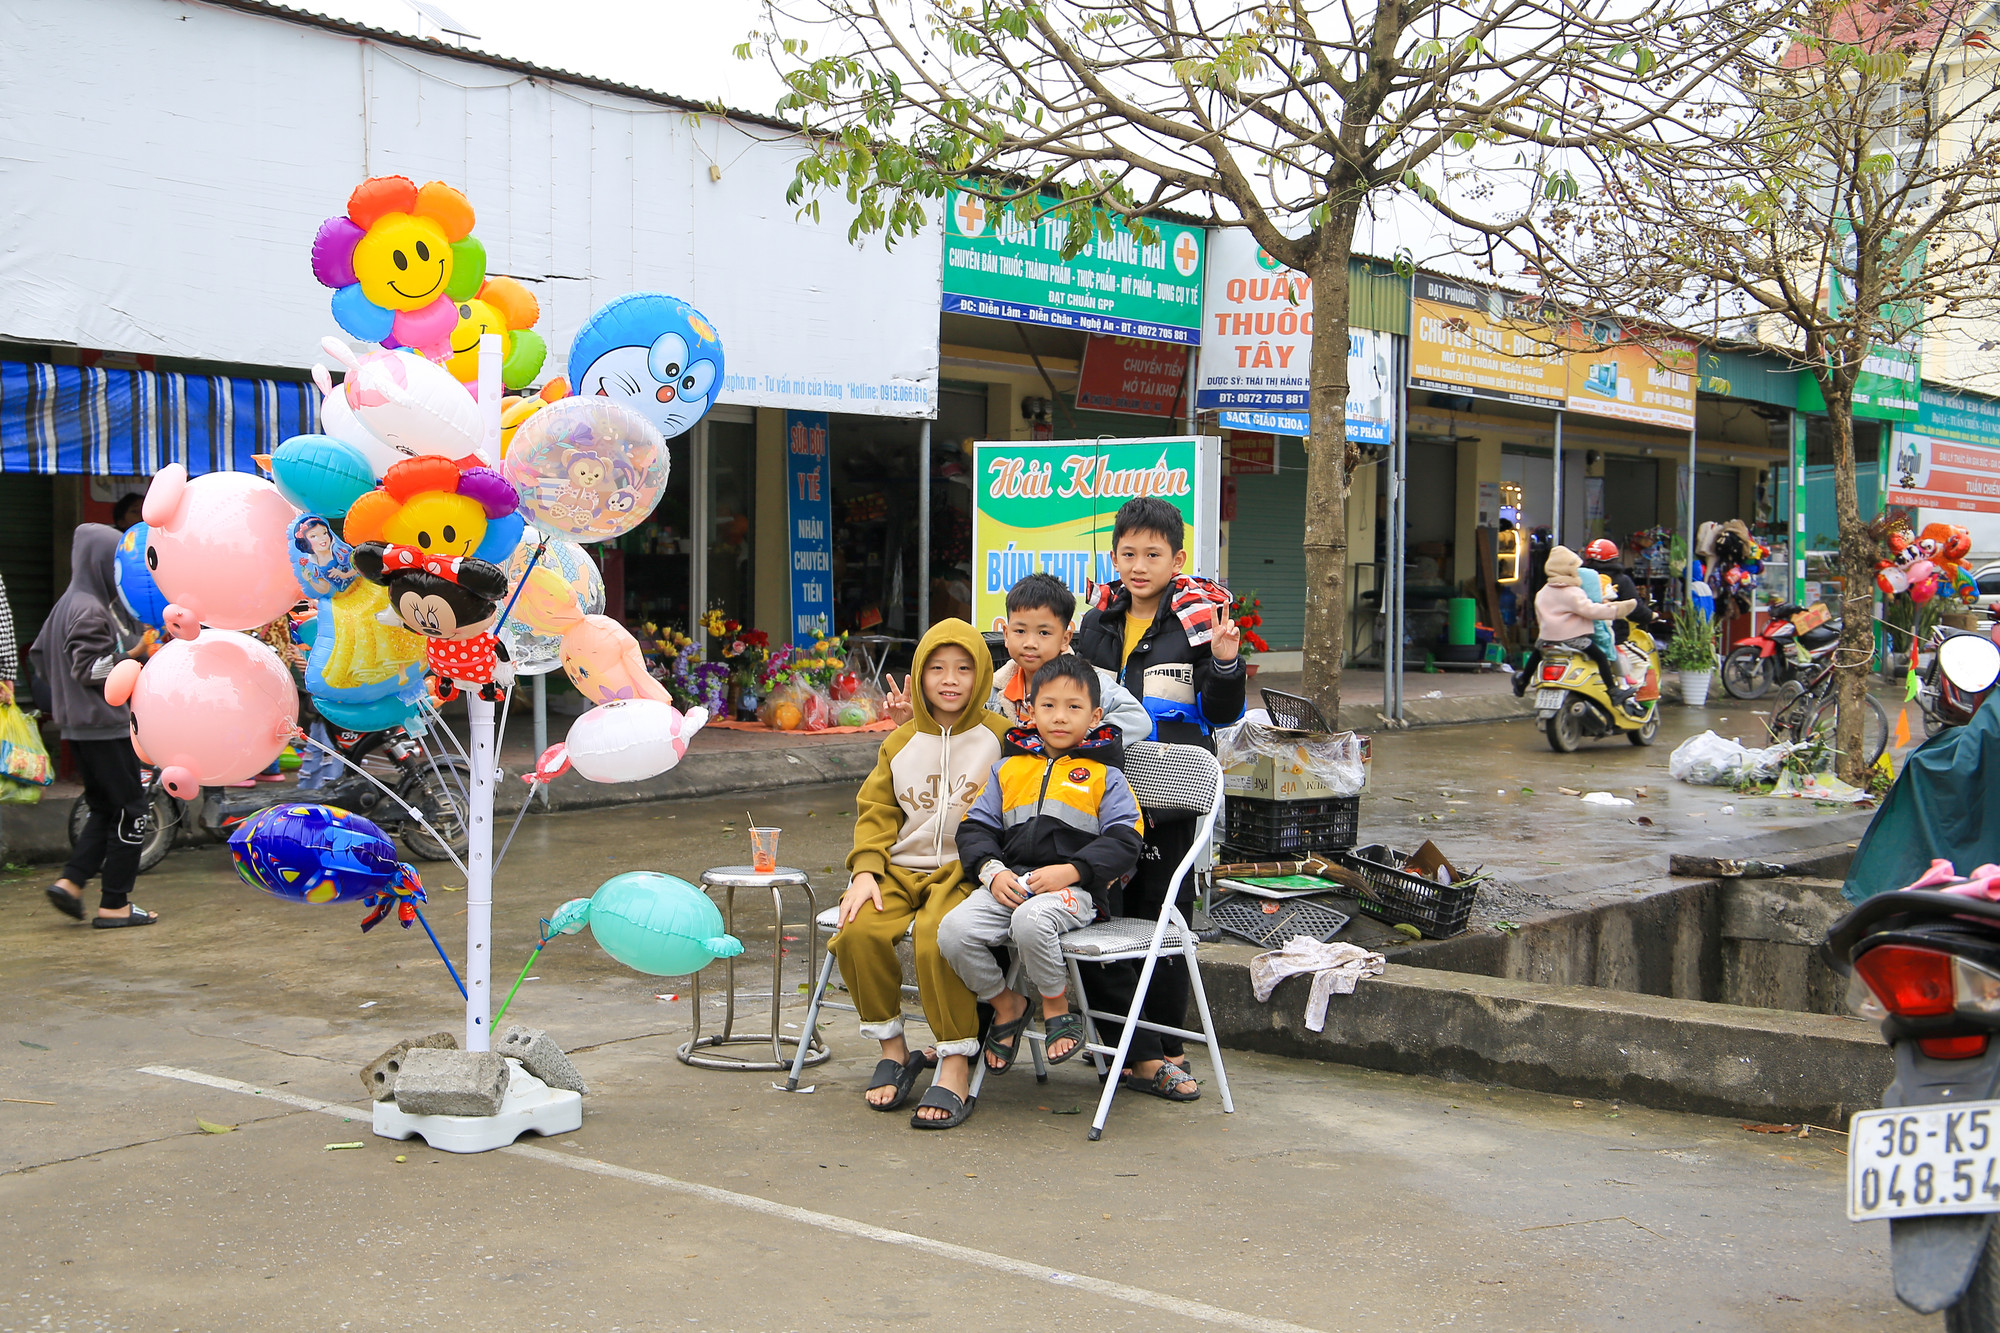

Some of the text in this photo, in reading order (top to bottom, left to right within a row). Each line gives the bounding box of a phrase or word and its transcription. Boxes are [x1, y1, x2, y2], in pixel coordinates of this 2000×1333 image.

[1043, 217, 1093, 257] THC
[949, 247, 980, 270] CHUYÊN
[982, 250, 998, 273] BÁN
[1000, 252, 1023, 277] THUỐC
[1025, 258, 1048, 281] THÀNH
[1157, 283, 1174, 304] DỤNG
[1185, 287, 1190, 305] Y
[1048, 290, 1114, 311] ĐẠT CHUẨN GPP
[1427, 283, 1443, 300] ĐẠT
[960, 299, 976, 312] ĐC:
[1001, 305, 1021, 318] Lâm
[1050, 312, 1072, 325] Châu
[1080, 316, 1101, 331] Nghệ
[1103, 320, 1114, 331] An
[1138, 325, 1157, 336] 0972
[1158, 328, 1173, 339] 705
[1174, 331, 1188, 341] 881
[1234, 340, 1295, 368] TÂY
[1457, 351, 1470, 366] TÀI
[723, 372, 757, 391] gpho.vn
[765, 375, 774, 392] Tư
[776, 373, 791, 394] vấn
[793, 376, 805, 395] mở
[823, 380, 843, 399] hàng
[880, 384, 928, 403] 0915.066.616
[1246, 375, 1263, 386] THÁI
[1265, 377, 1278, 387] THỊ
[1219, 393, 1303, 404] ĐT: 0972 705 881
[1946, 397, 1964, 410] KHO
[1278, 416, 1303, 430] KHOA
[810, 423, 826, 462] BỘT
[798, 465, 821, 501] Y TẾ
[988, 455, 1053, 499] Hải
[798, 515, 823, 544] NHẬN
[794, 544, 829, 571] CHUYỂN
[1876, 1110, 1990, 1158] 36-K5
[1862, 1157, 2000, 1210] 048.54
